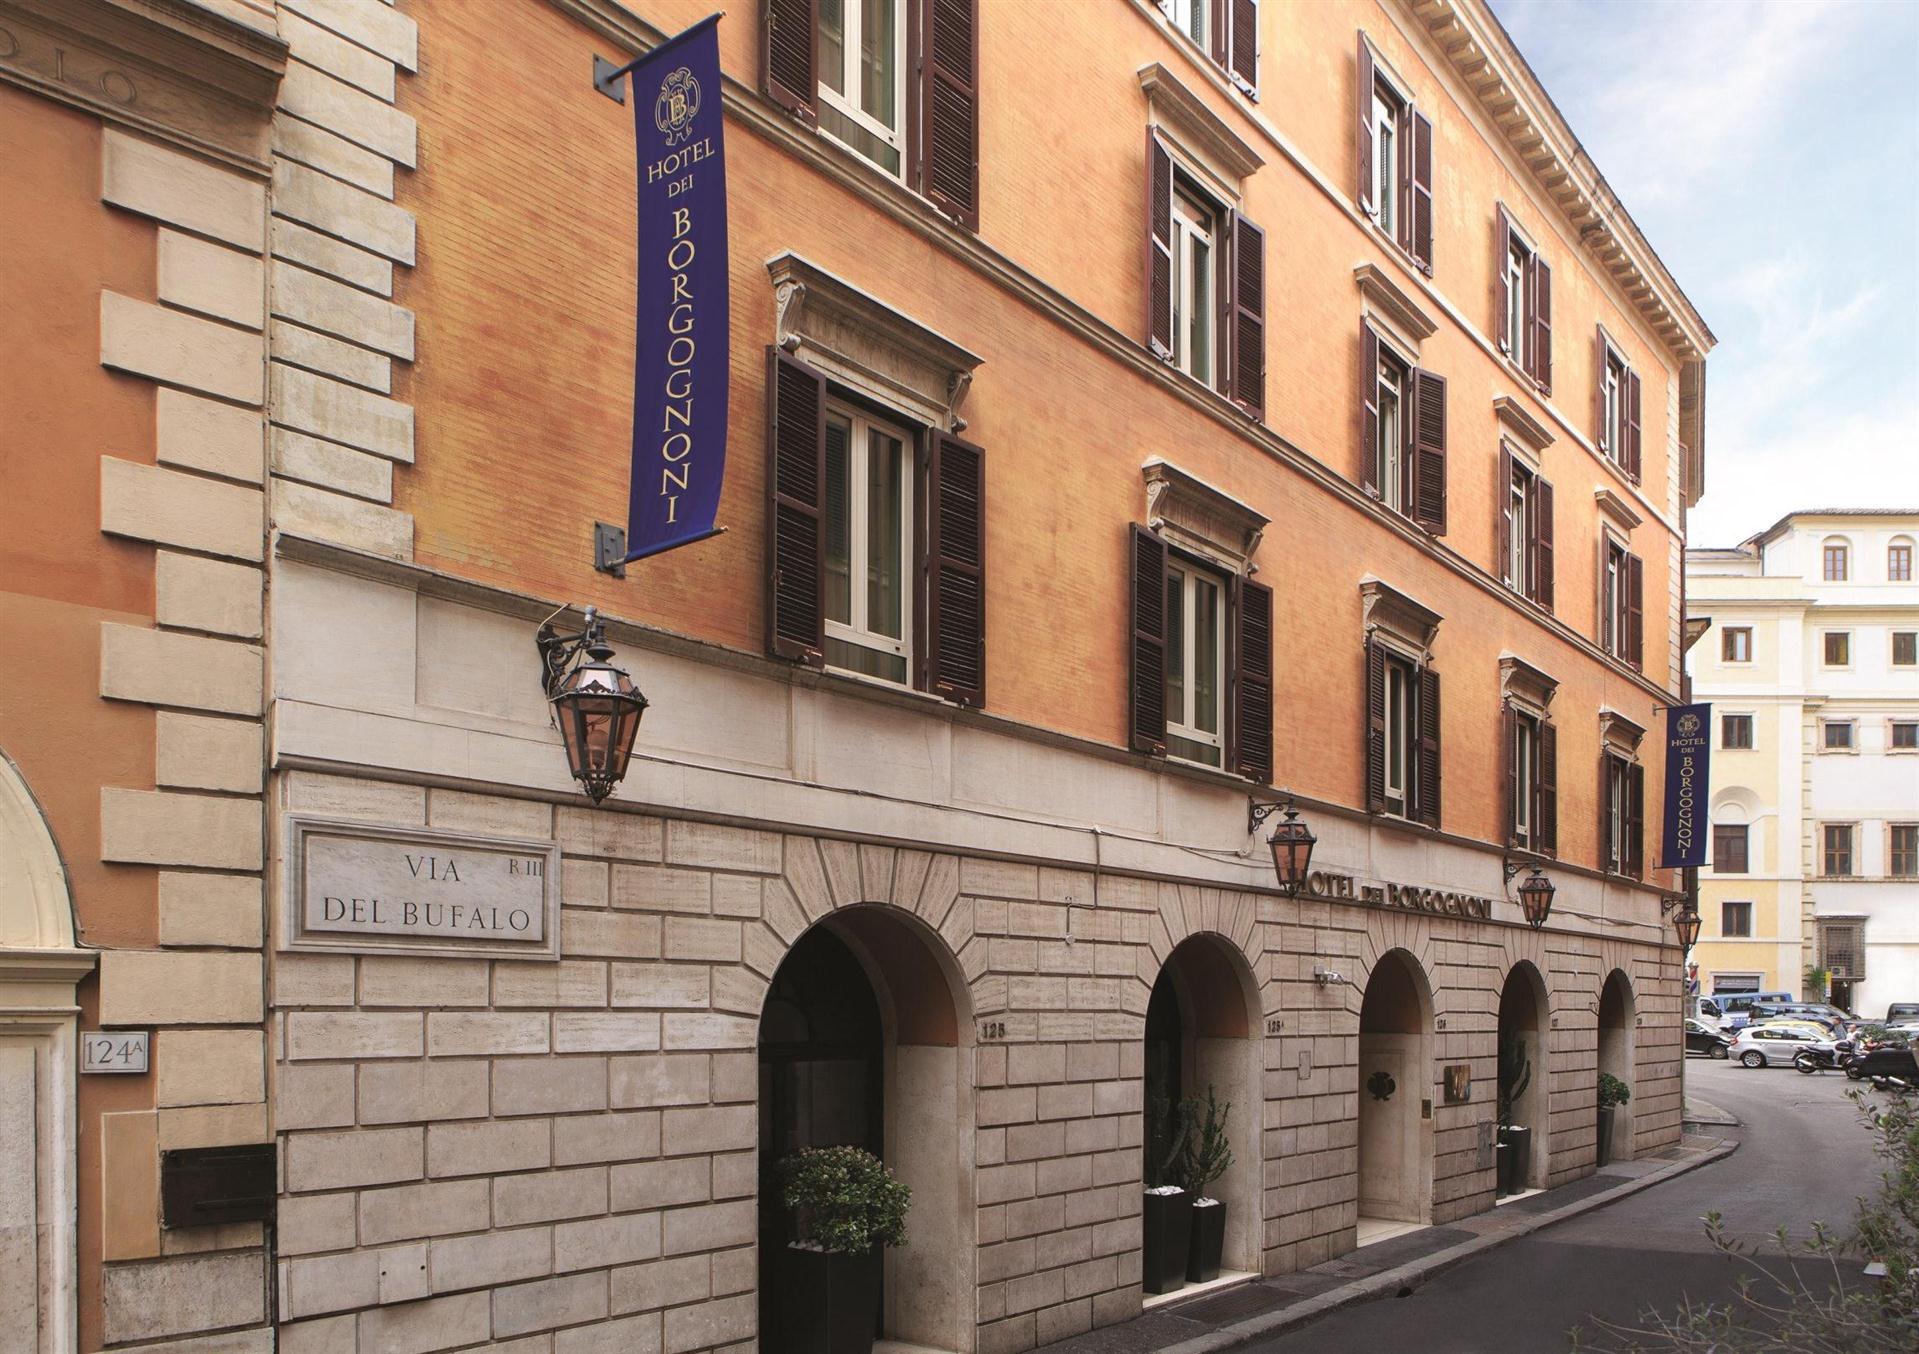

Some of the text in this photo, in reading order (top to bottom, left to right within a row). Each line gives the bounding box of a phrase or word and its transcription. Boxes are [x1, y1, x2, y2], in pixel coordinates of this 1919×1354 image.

[647, 138, 715, 184] HOTEL
[668, 174, 694, 198] DEI
[660, 207, 695, 524] BORGOGNONI
[1671, 738, 1706, 747] HOTEL
[1678, 757, 1694, 859] BORGOGNONI
[405, 855, 460, 881] VIA
[1299, 870, 1358, 898] OTEL
[324, 897, 530, 931] DEL BUFALO
